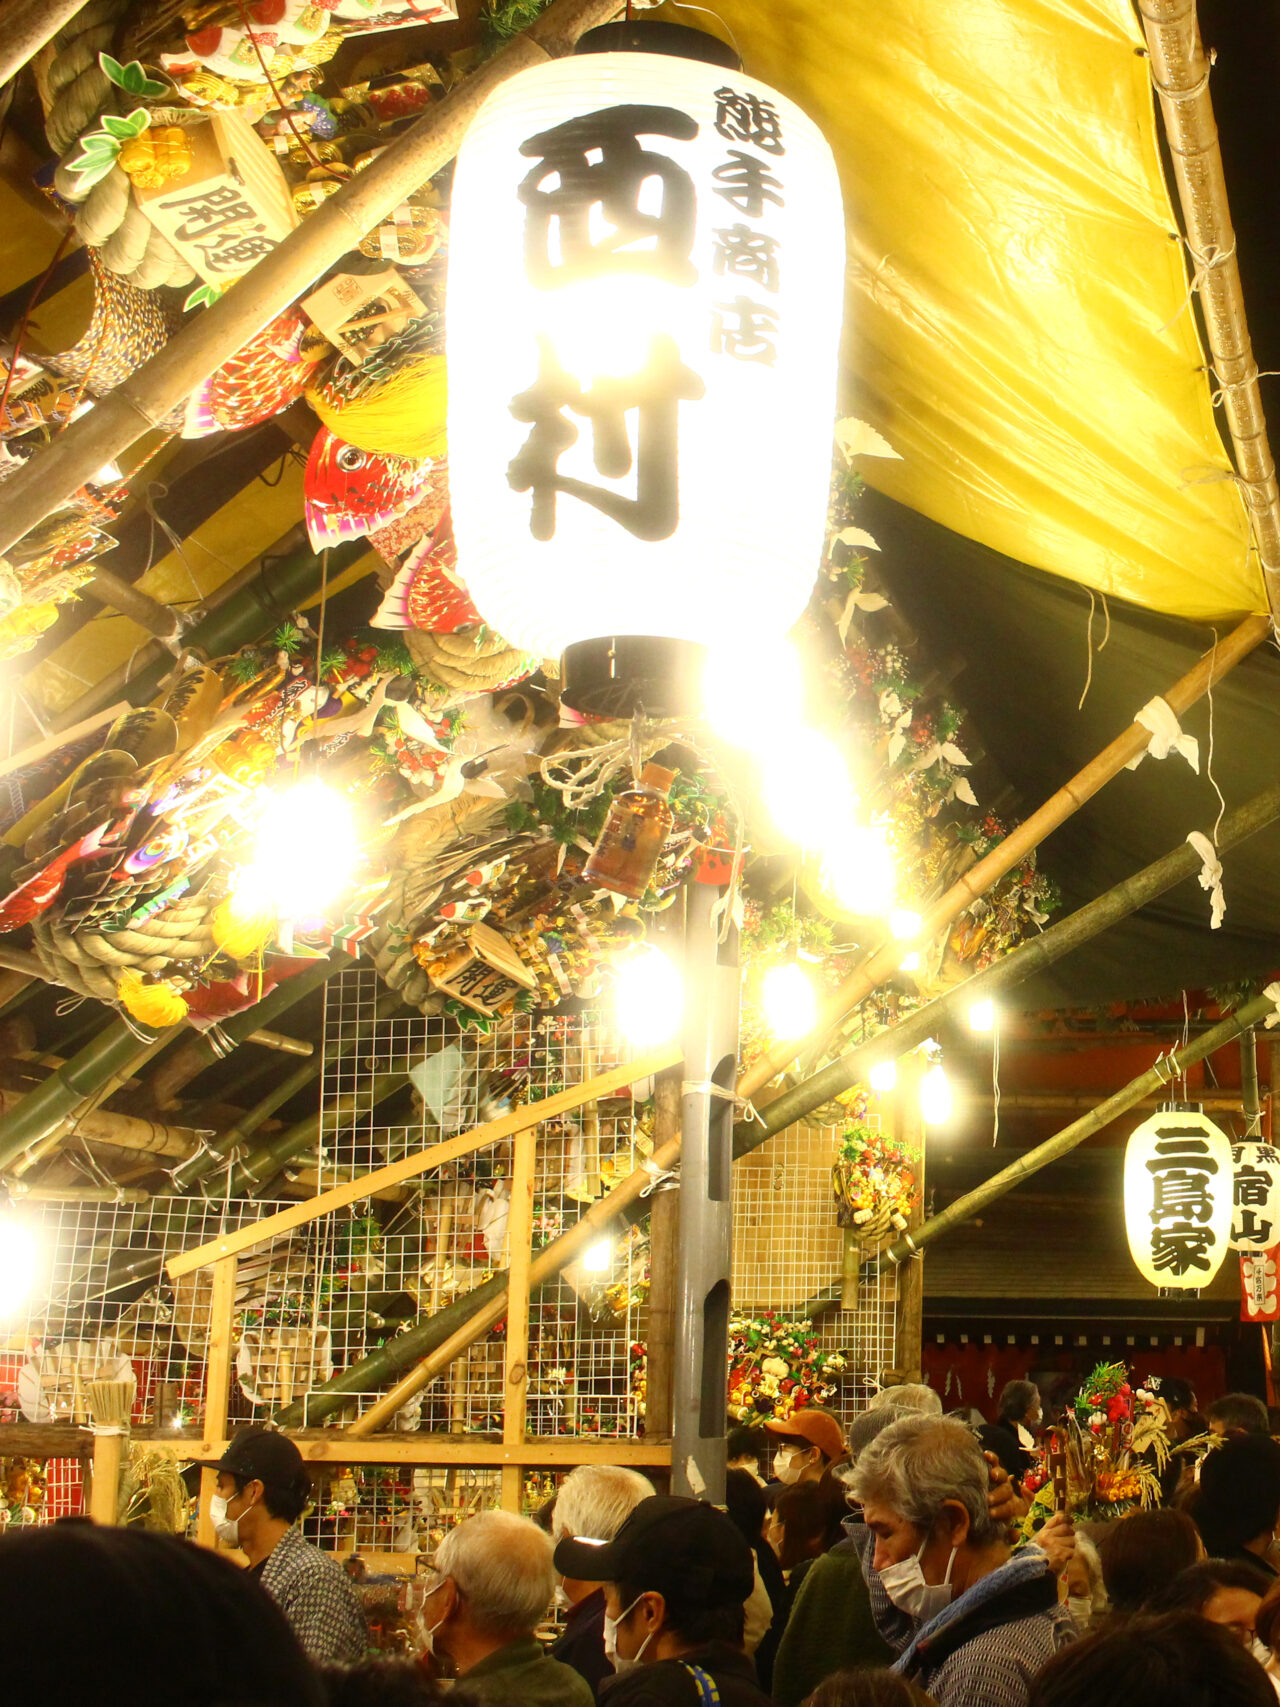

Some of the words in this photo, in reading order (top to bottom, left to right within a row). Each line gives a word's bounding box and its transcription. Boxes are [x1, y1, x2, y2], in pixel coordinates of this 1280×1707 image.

[505, 103, 706, 542] 西村
[710, 86, 786, 368] 熊手商店
[1145, 1126, 1219, 1276] 三島家
